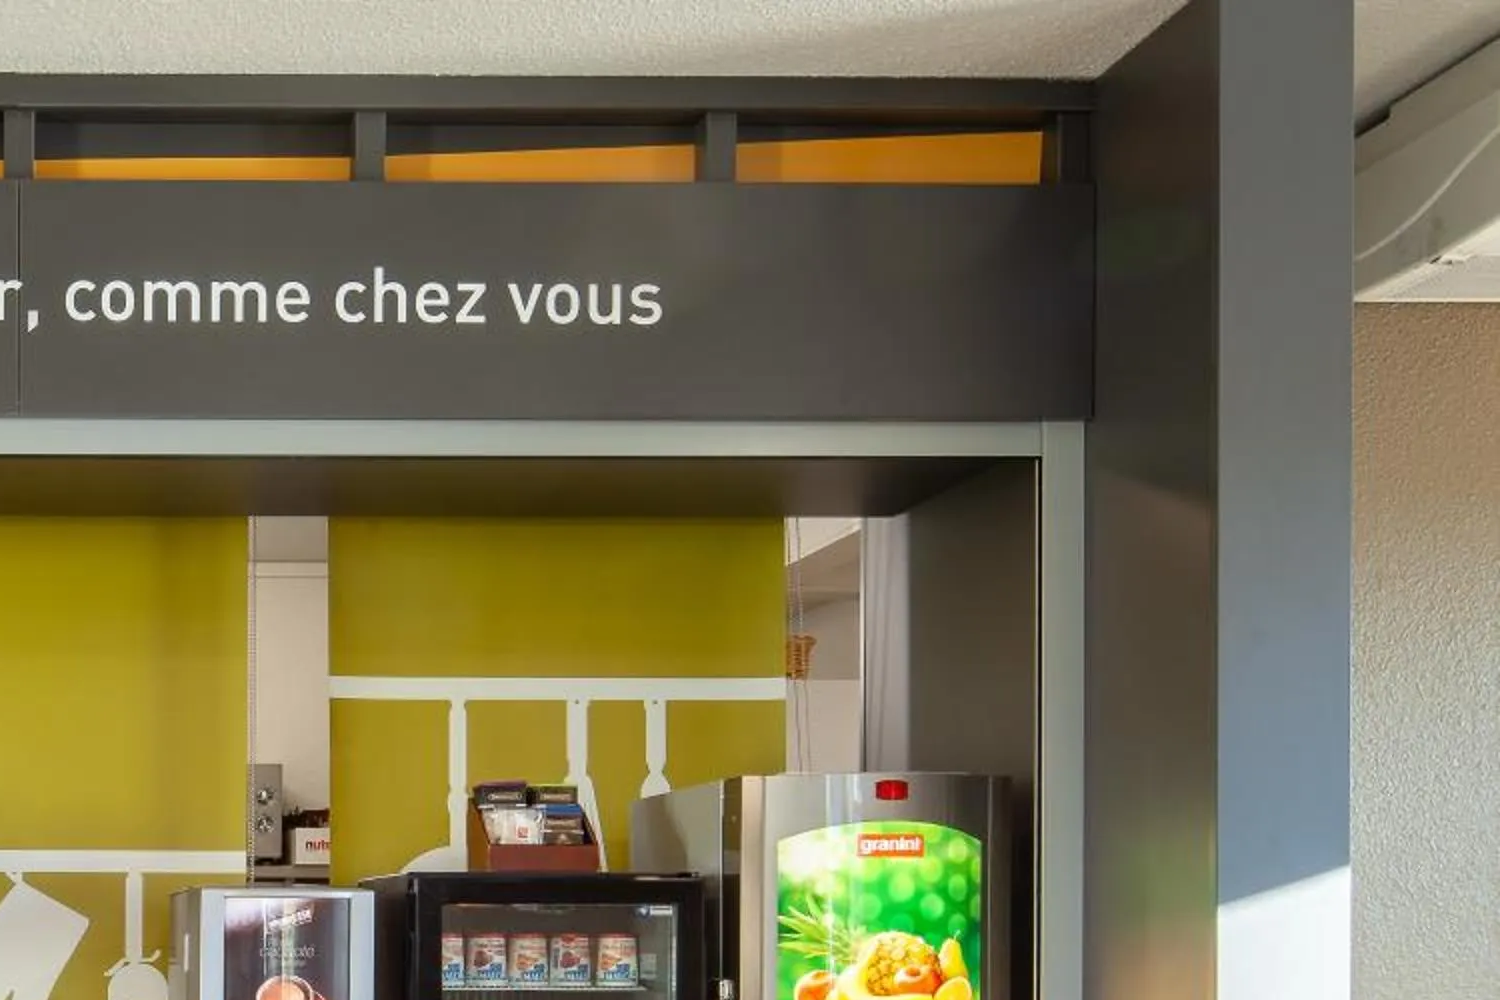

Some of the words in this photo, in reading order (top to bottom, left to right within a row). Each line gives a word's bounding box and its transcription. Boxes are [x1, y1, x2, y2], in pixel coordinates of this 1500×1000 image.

[64, 278, 312, 324] comme
[334, 265, 488, 325] chez
[506, 282, 664, 326] vous
[861, 836, 921, 855] granini
